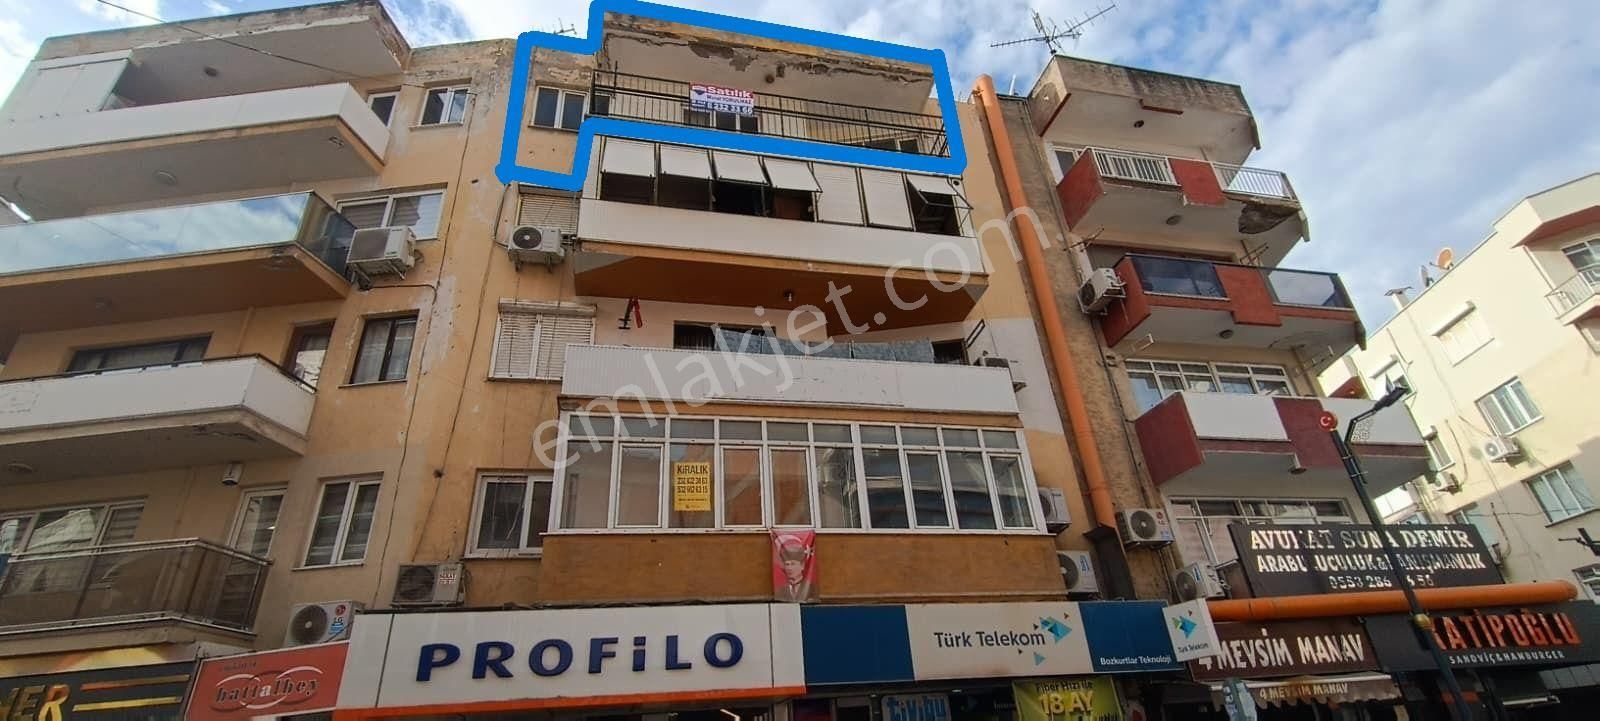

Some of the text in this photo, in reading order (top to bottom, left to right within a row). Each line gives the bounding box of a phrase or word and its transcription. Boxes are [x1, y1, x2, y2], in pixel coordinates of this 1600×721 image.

[707, 85, 752, 98] Satılık
[1251, 529, 1336, 550] AVUAT
[1328, 575, 1363, 589] 0553
[933, 629, 1046, 648] Türk Telekom
[1218, 628, 1295, 670] MEVSİM
[1297, 633, 1365, 665] MANAV
[1100, 654, 1172, 666] Bozkurtlar Teknoloji
[1039, 692, 1065, 713] 18
[1068, 691, 1094, 712] AY
